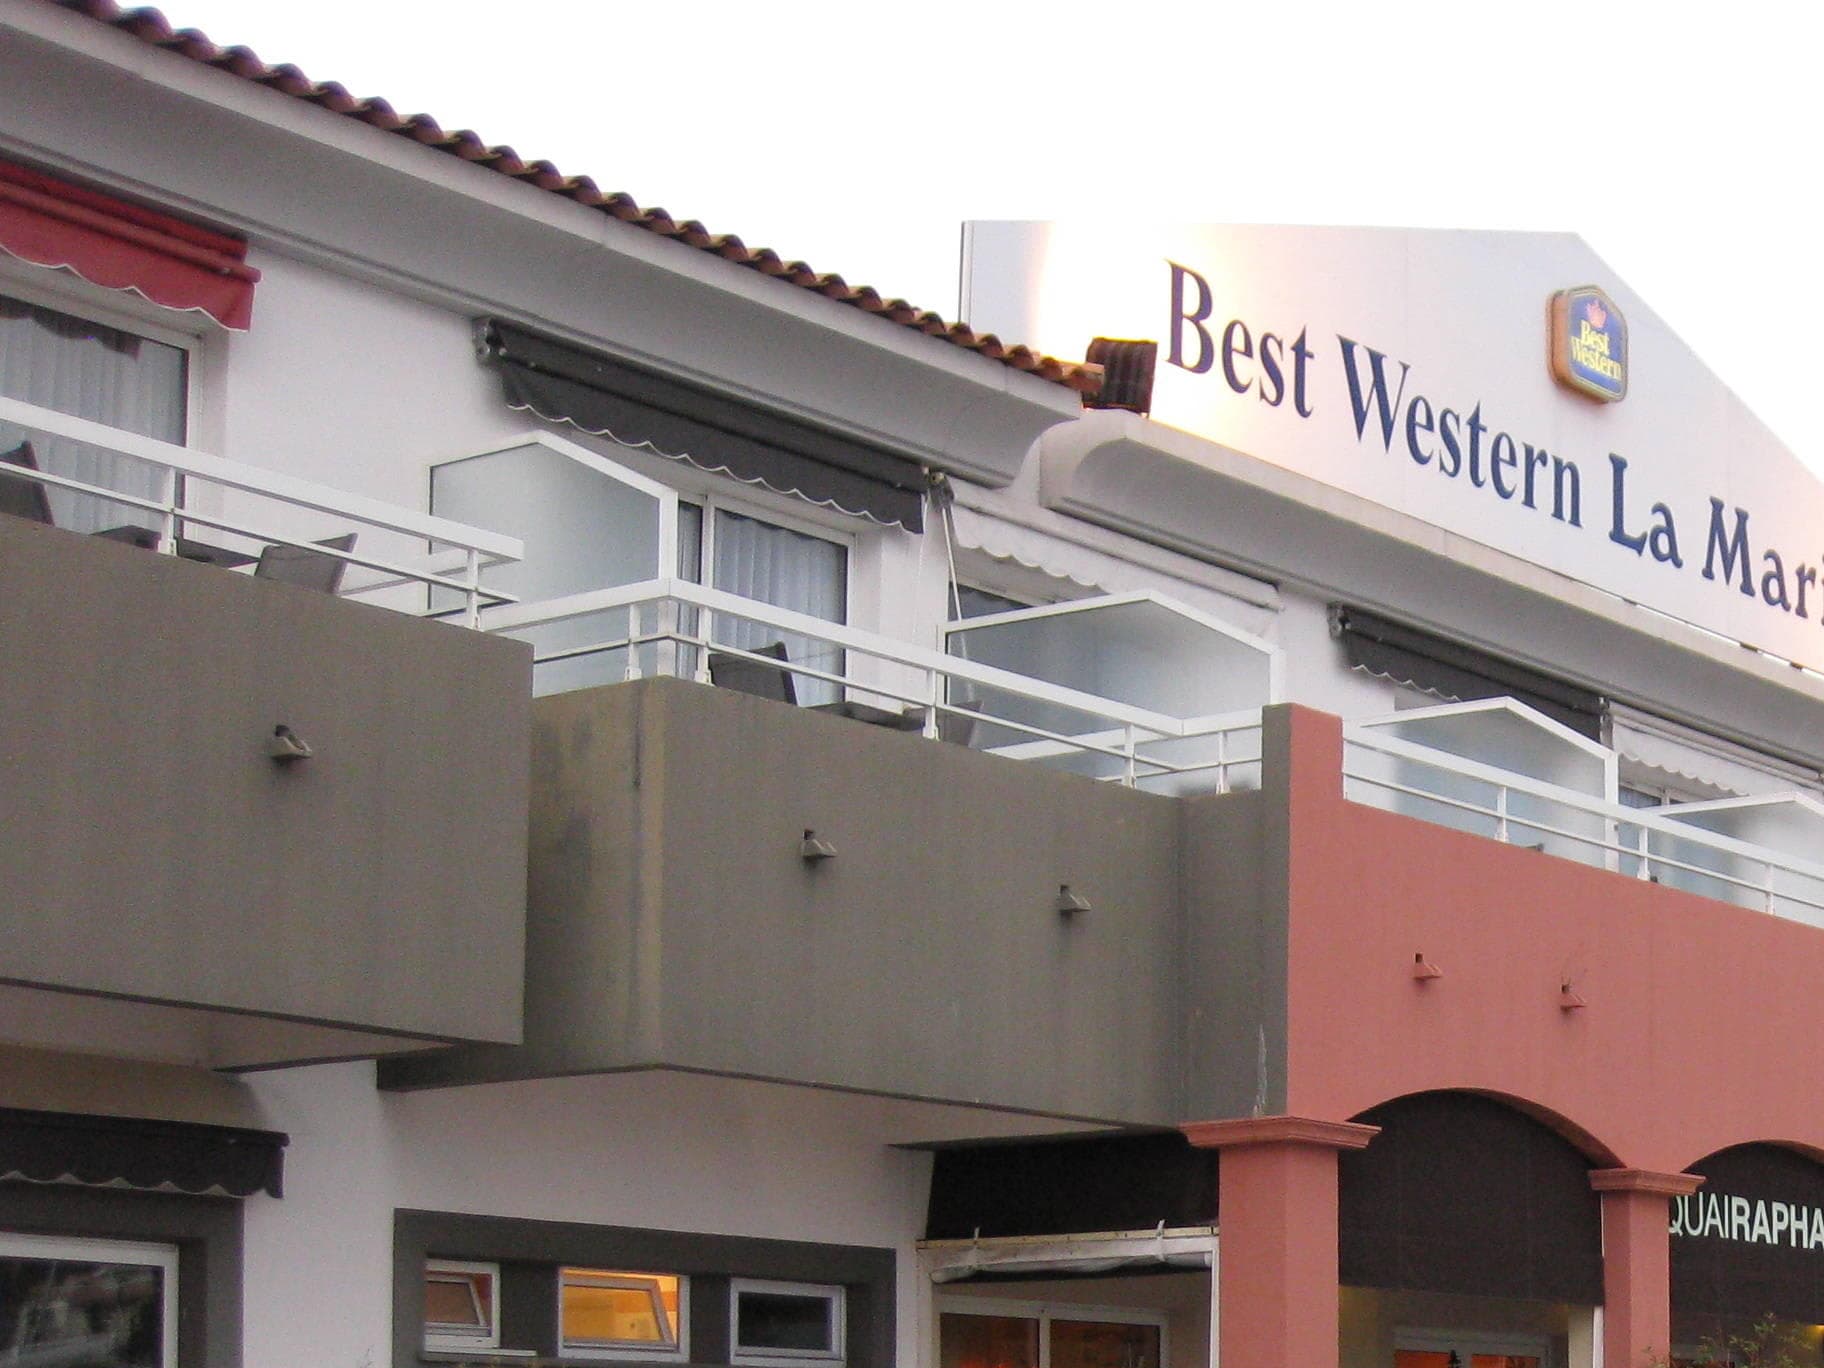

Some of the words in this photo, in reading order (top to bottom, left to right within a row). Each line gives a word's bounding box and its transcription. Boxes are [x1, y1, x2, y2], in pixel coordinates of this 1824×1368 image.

[1570, 335, 1622, 381] Western
[1580, 319, 1610, 356] Best
[1164, 258, 1315, 418] Best
[1336, 333, 1583, 529] Western
[1608, 452, 1683, 570] La
